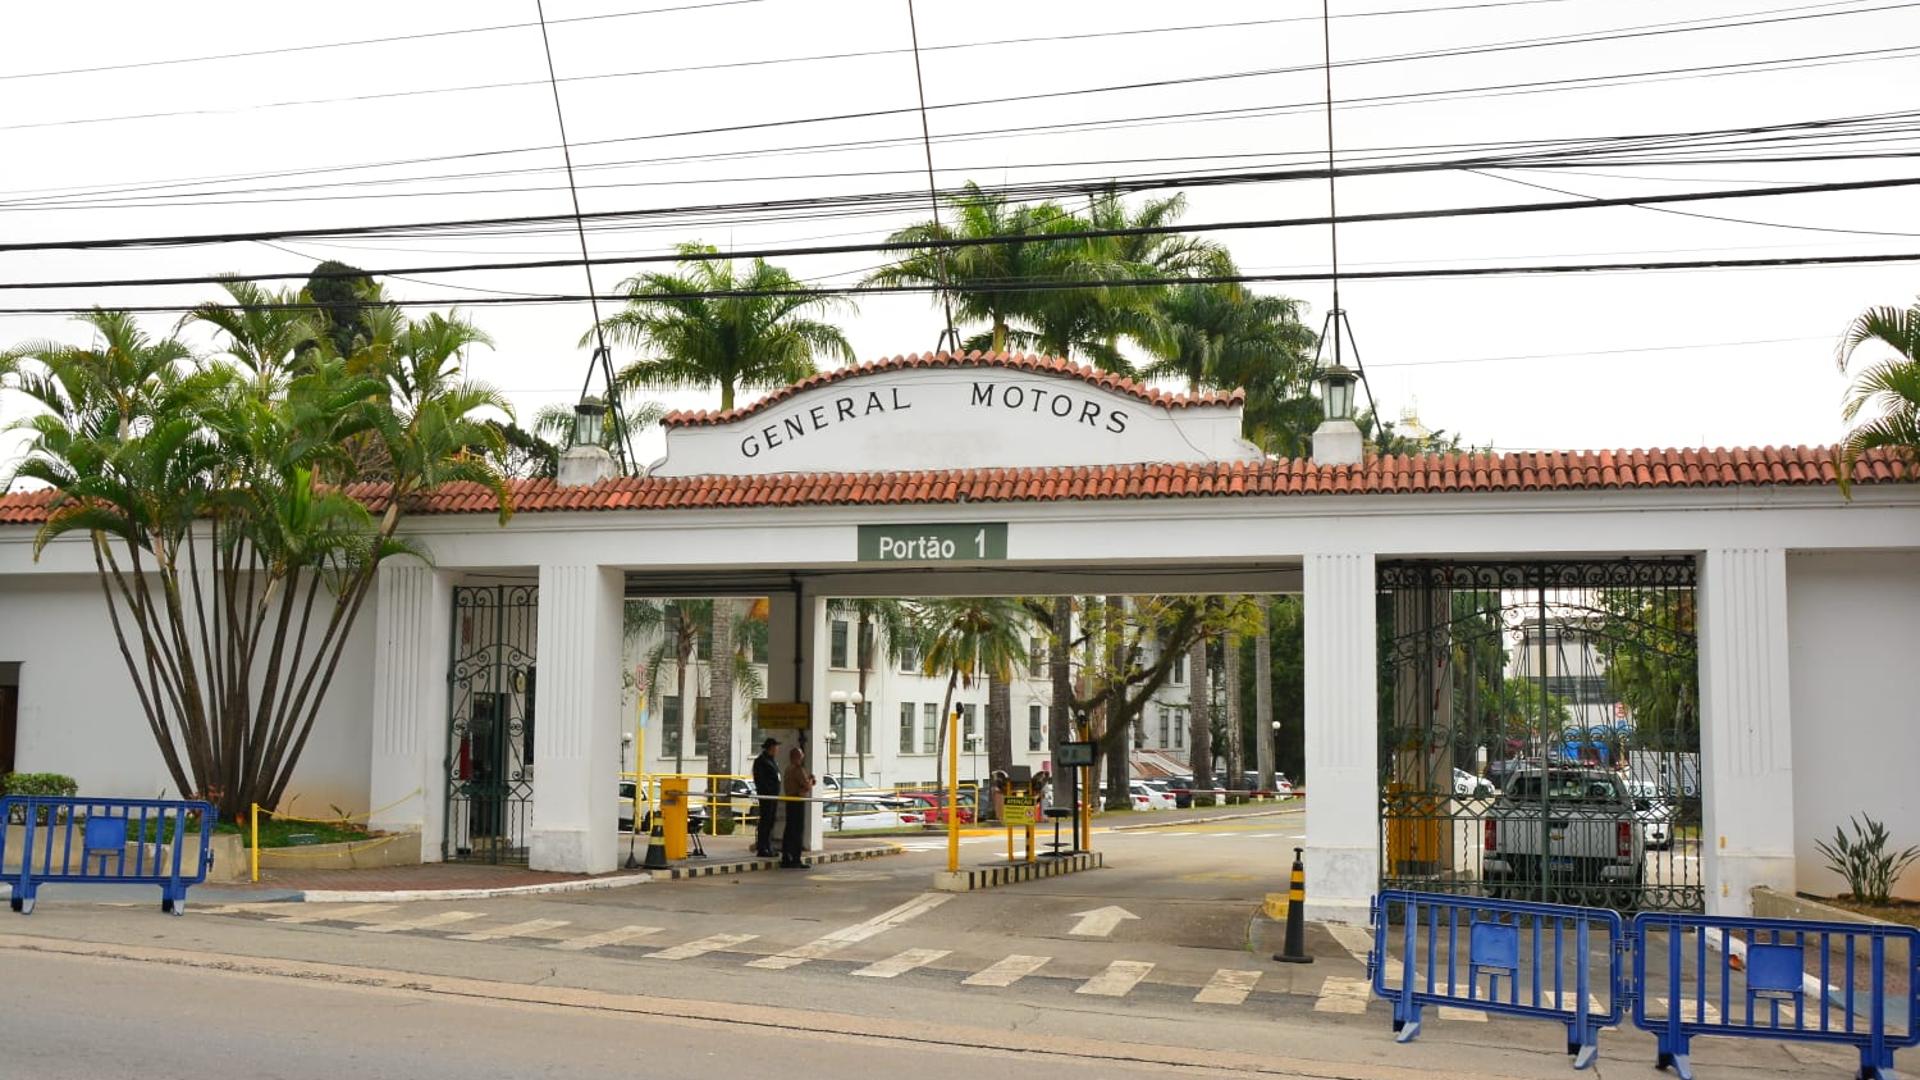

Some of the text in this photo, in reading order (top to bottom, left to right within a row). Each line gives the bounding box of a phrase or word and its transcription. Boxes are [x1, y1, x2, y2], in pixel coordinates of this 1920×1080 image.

[741, 382, 1129, 458] GENERAL MOTORS
[879, 528, 986, 560] Portão 1
